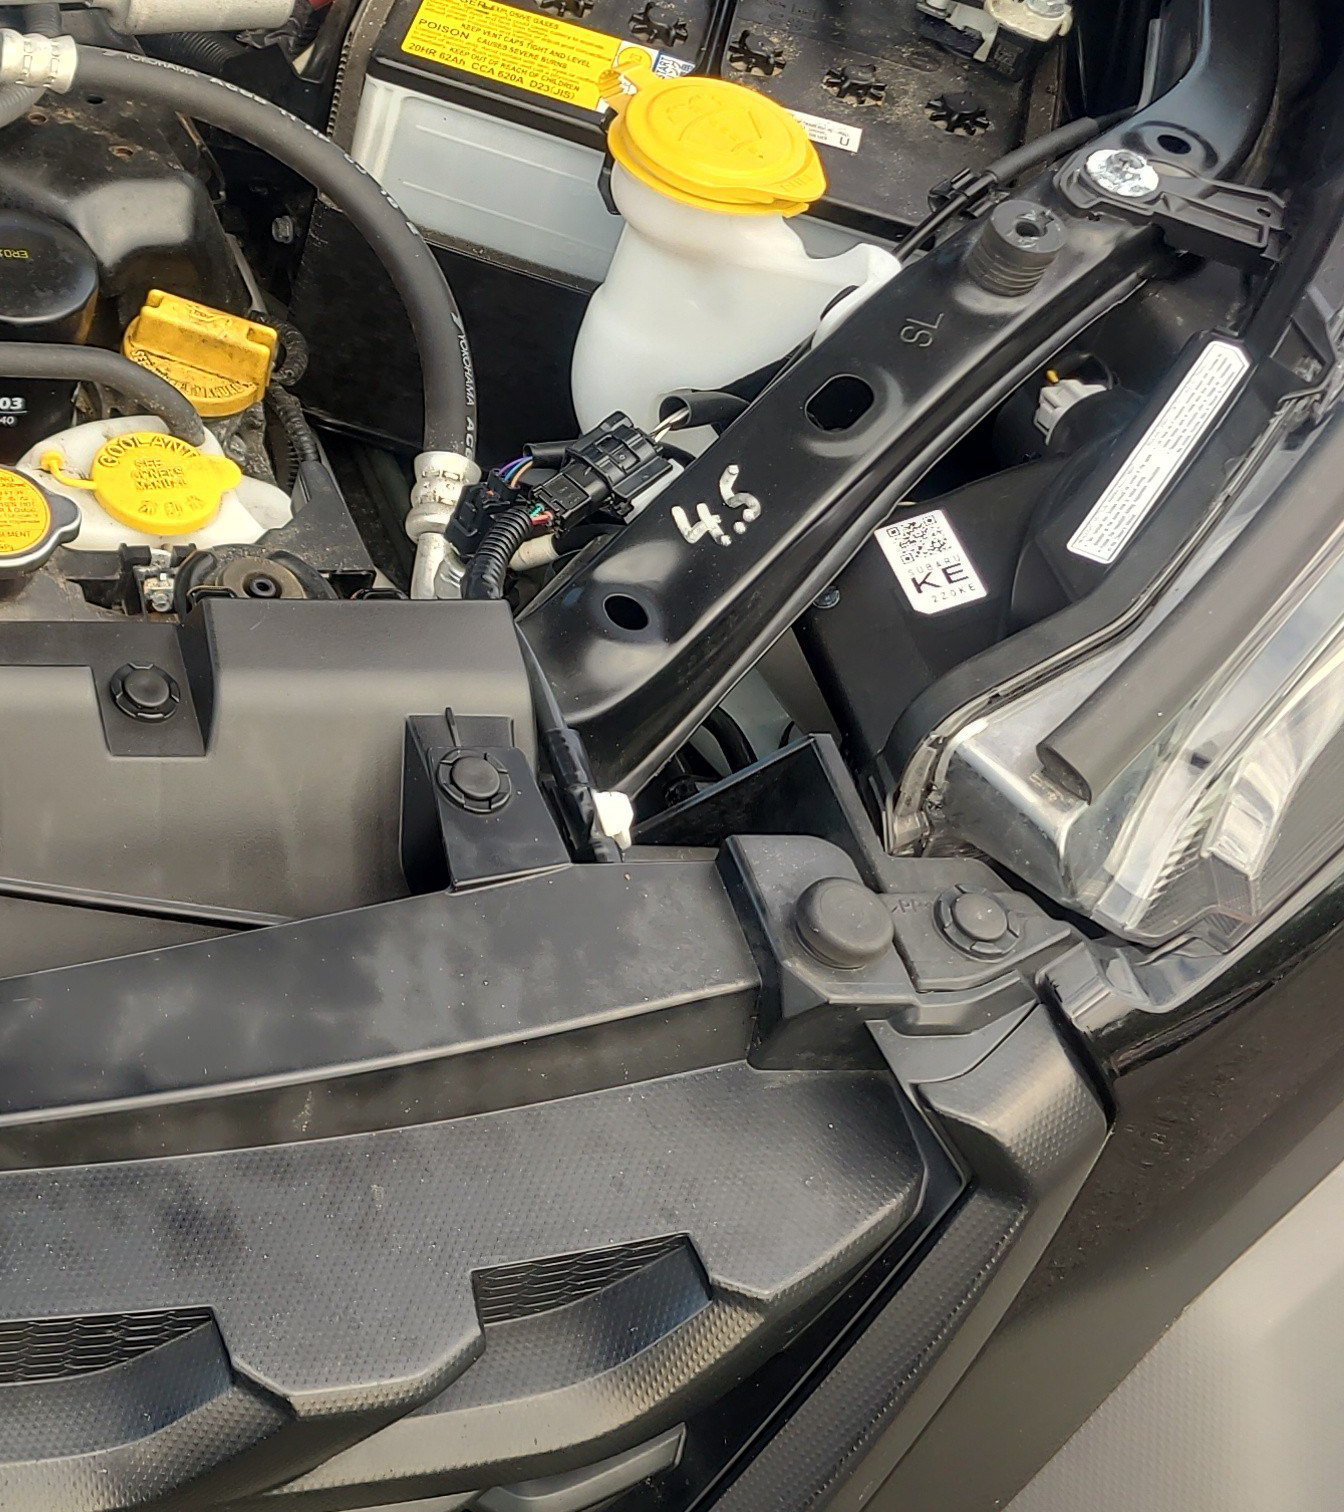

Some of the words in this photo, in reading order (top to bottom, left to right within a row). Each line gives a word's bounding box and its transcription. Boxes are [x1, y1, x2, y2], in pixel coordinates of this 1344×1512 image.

[418, 18, 470, 40] POISON
[408, 42, 437, 58] 20HR
[471, 61, 495, 75] CCA
[497, 69, 524, 84] 620A
[529, 79, 576, 100] D23(JIS)
[900, 312, 944, 347] SL
[457, 333, 476, 406] YOKOHAMA
[98, 434, 200, 467] COOLANT
[908, 554, 961, 576] SUBARU
[911, 562, 969, 594] KE
